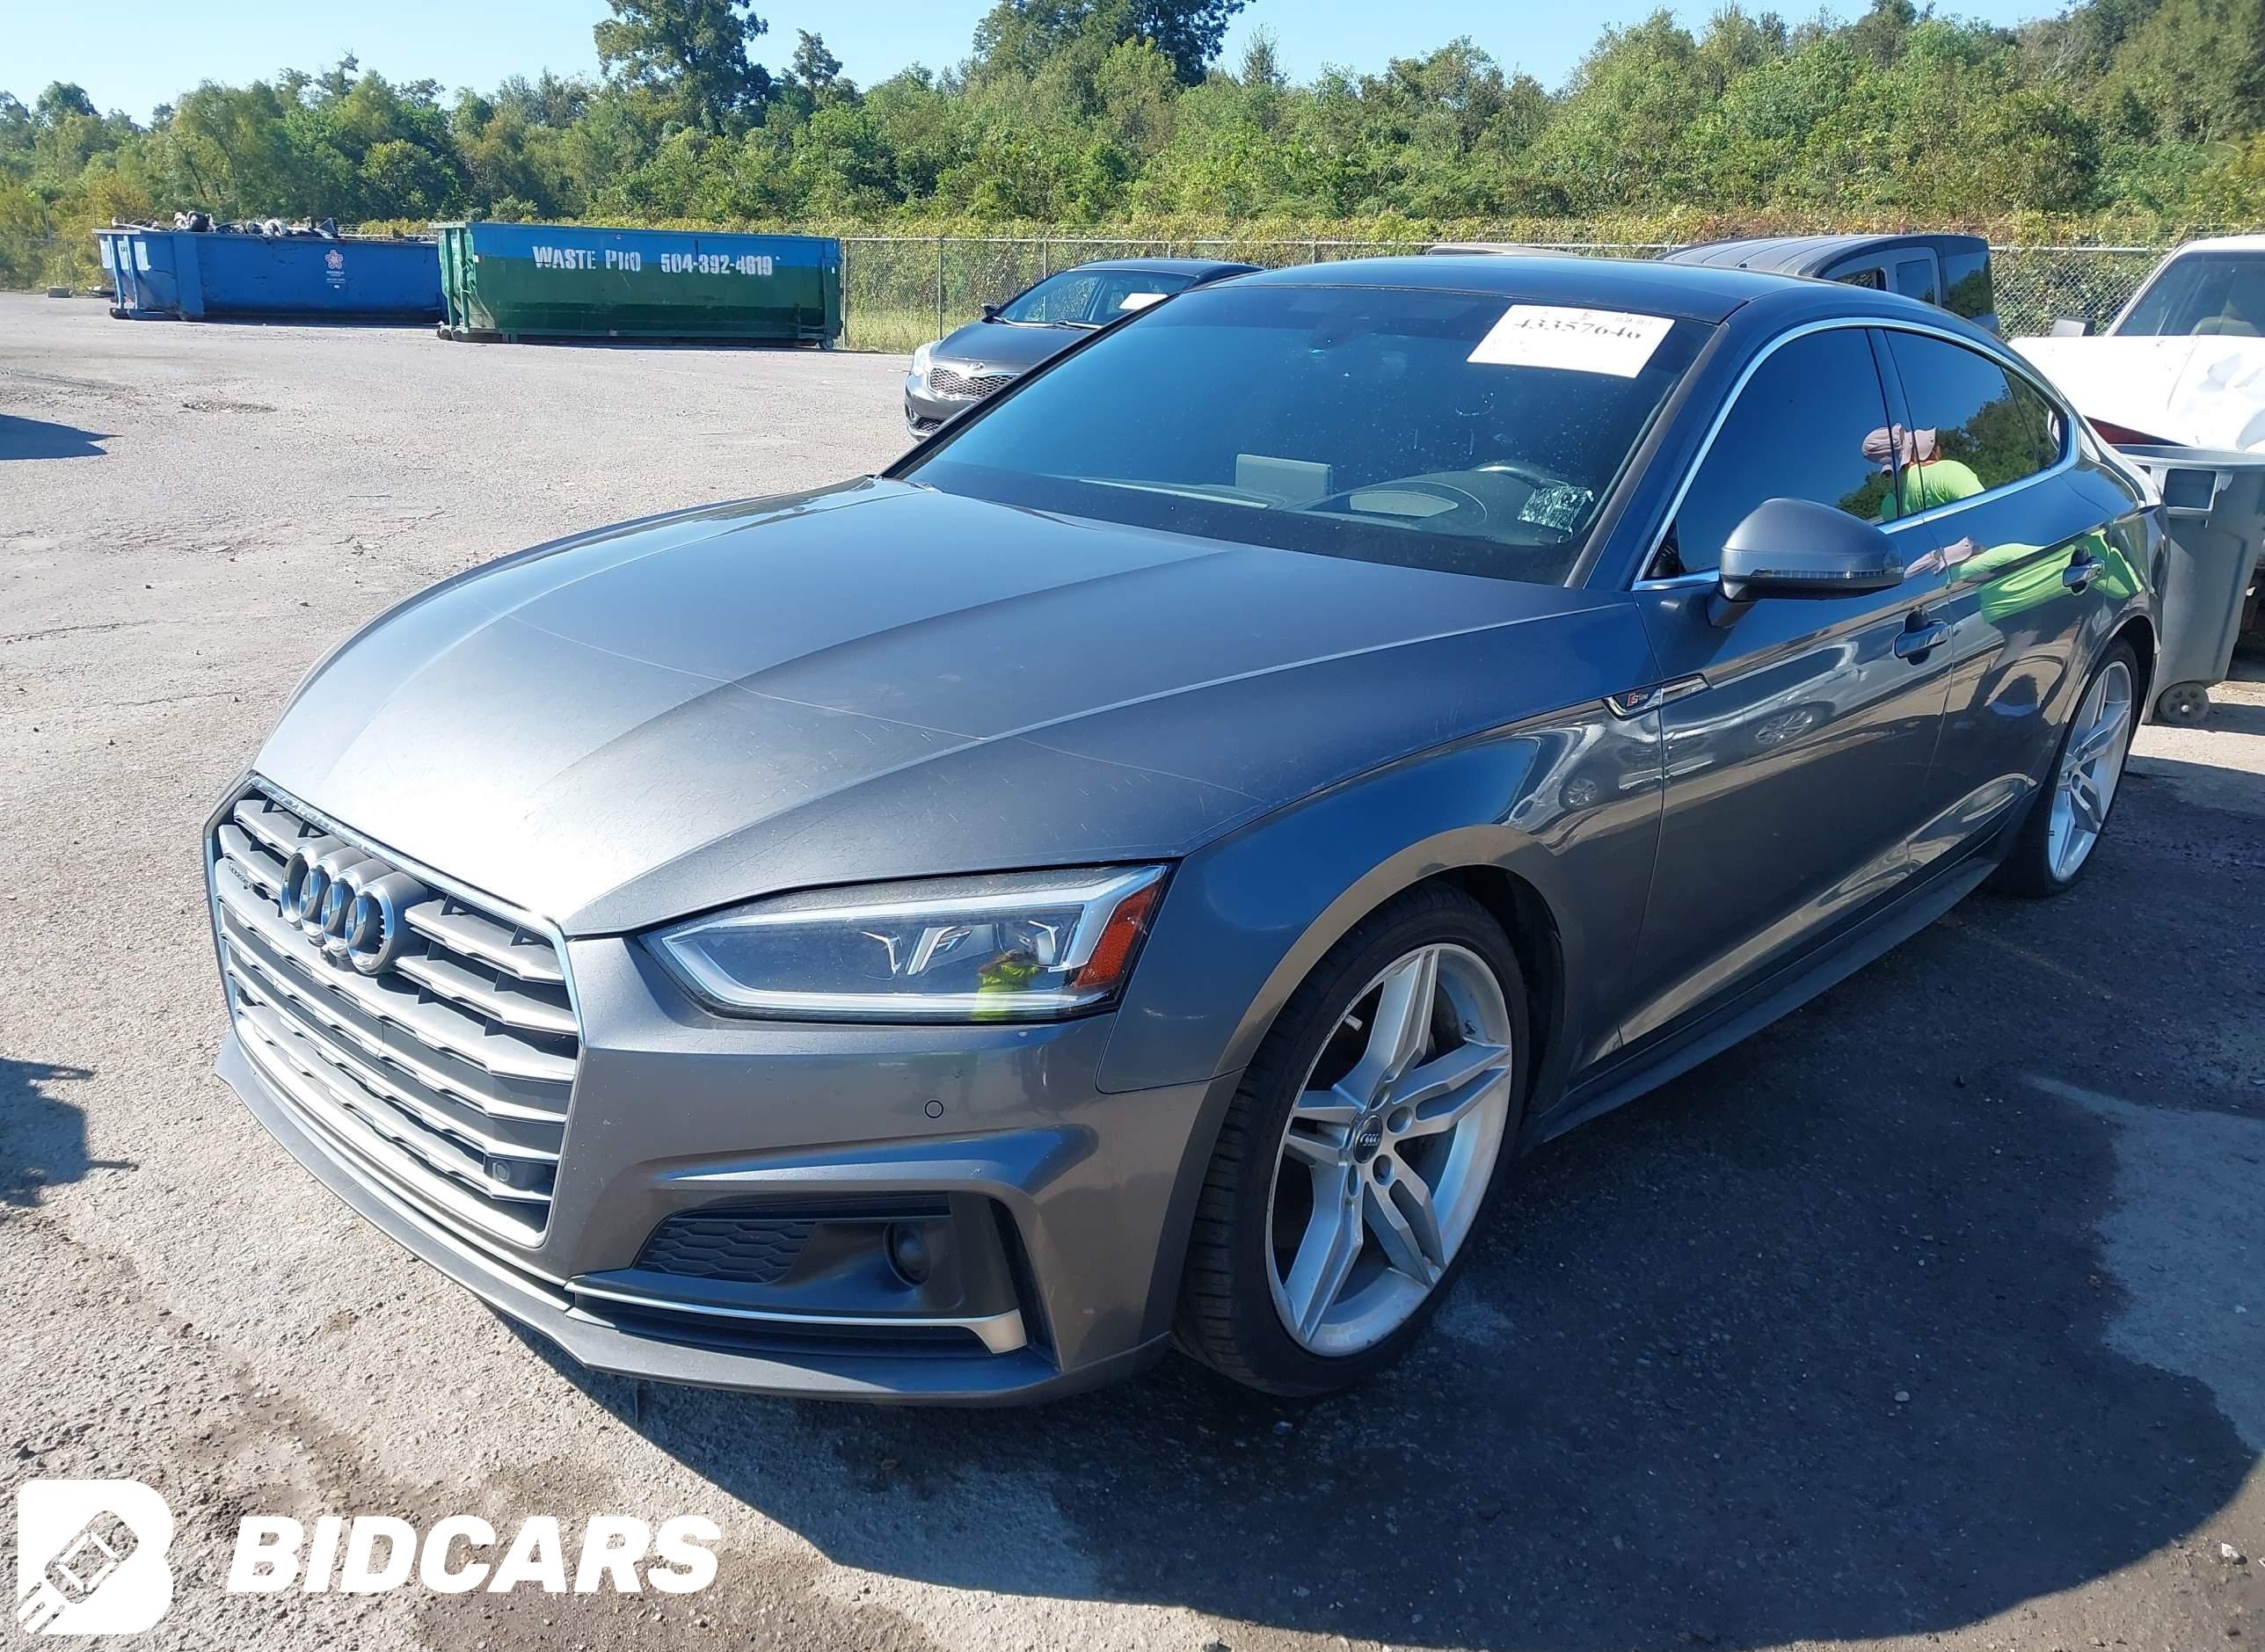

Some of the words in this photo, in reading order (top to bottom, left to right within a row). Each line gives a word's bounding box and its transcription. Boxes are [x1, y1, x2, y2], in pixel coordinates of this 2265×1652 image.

[532, 246, 597, 269] WASTE
[605, 249, 641, 272] PRO
[660, 253, 773, 275] 504-392-4619
